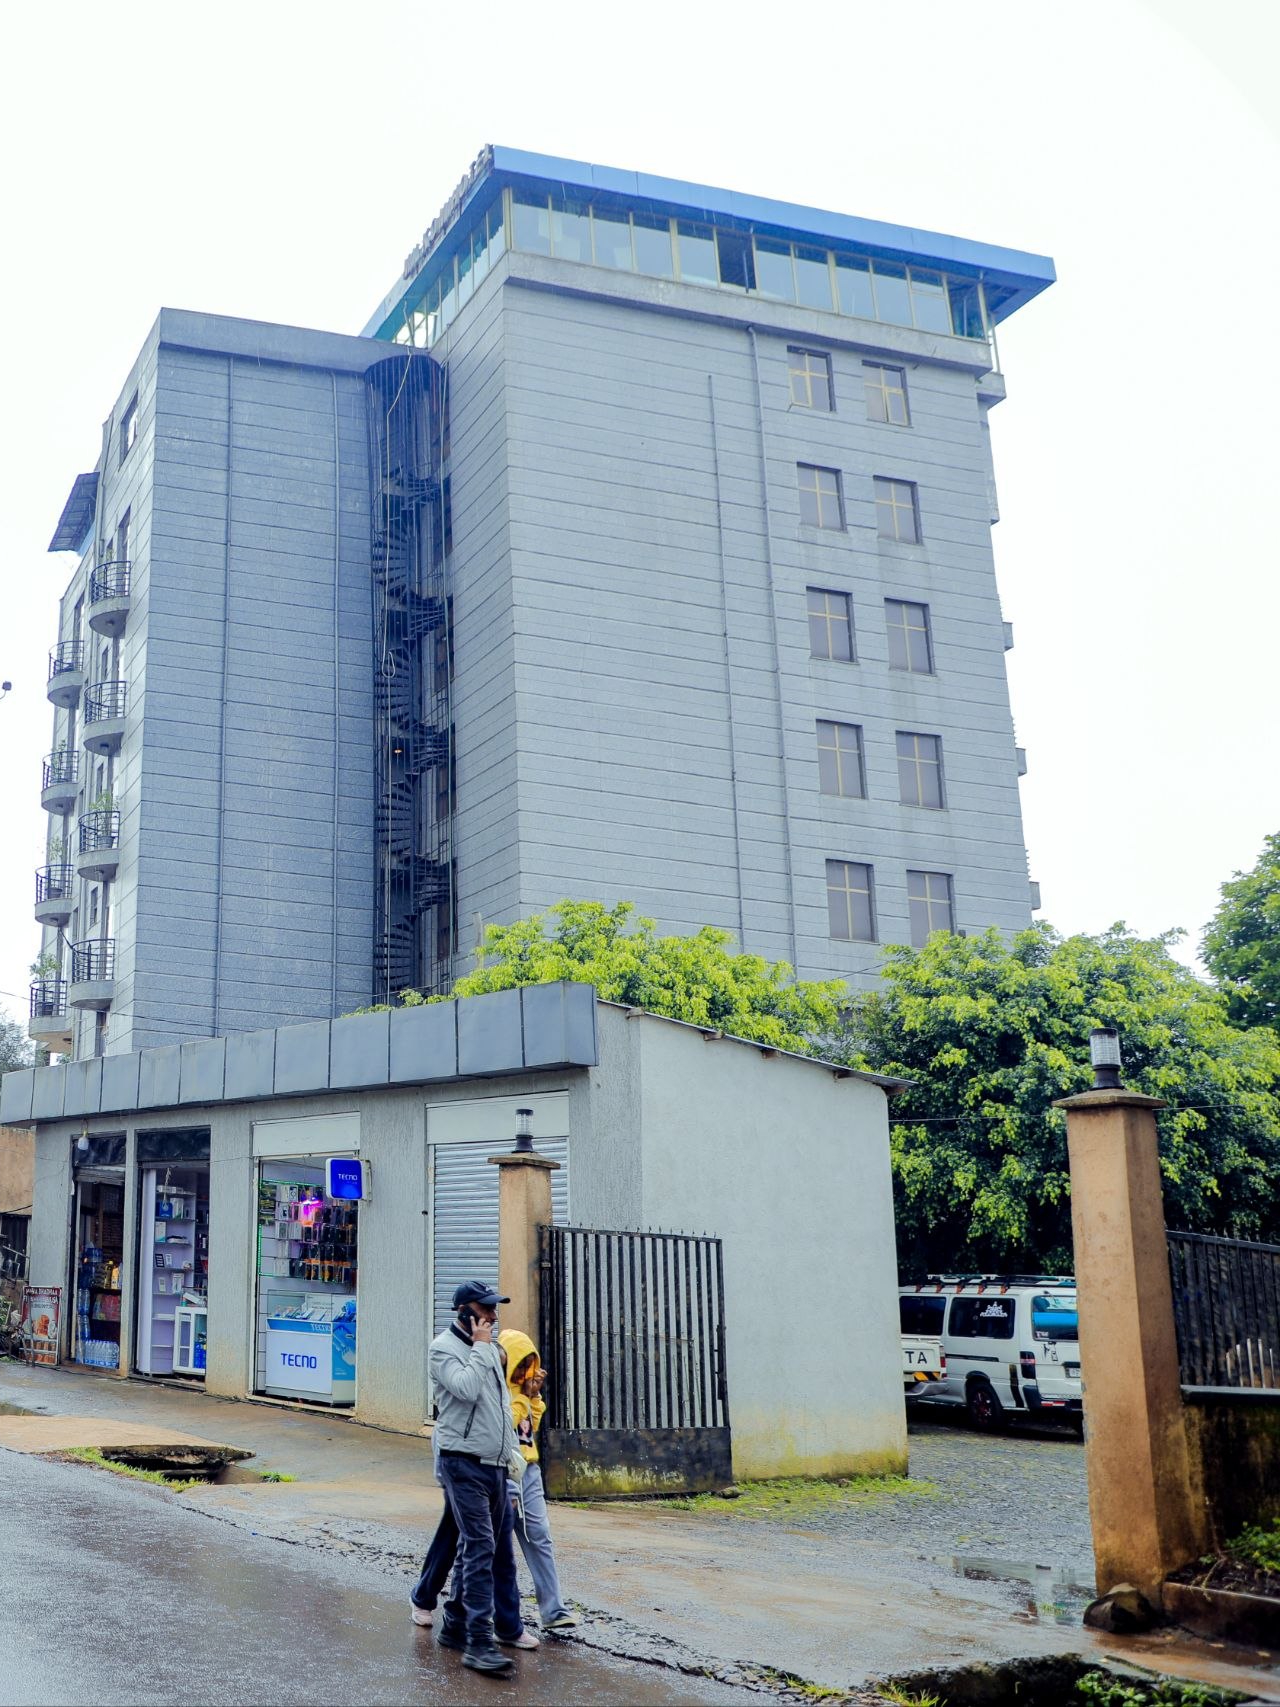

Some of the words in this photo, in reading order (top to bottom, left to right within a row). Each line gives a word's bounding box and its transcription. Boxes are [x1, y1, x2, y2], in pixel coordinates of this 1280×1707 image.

[338, 1173, 358, 1181] TECNO
[280, 1352, 317, 1369] TECNO
[904, 1350, 928, 1364] TA
